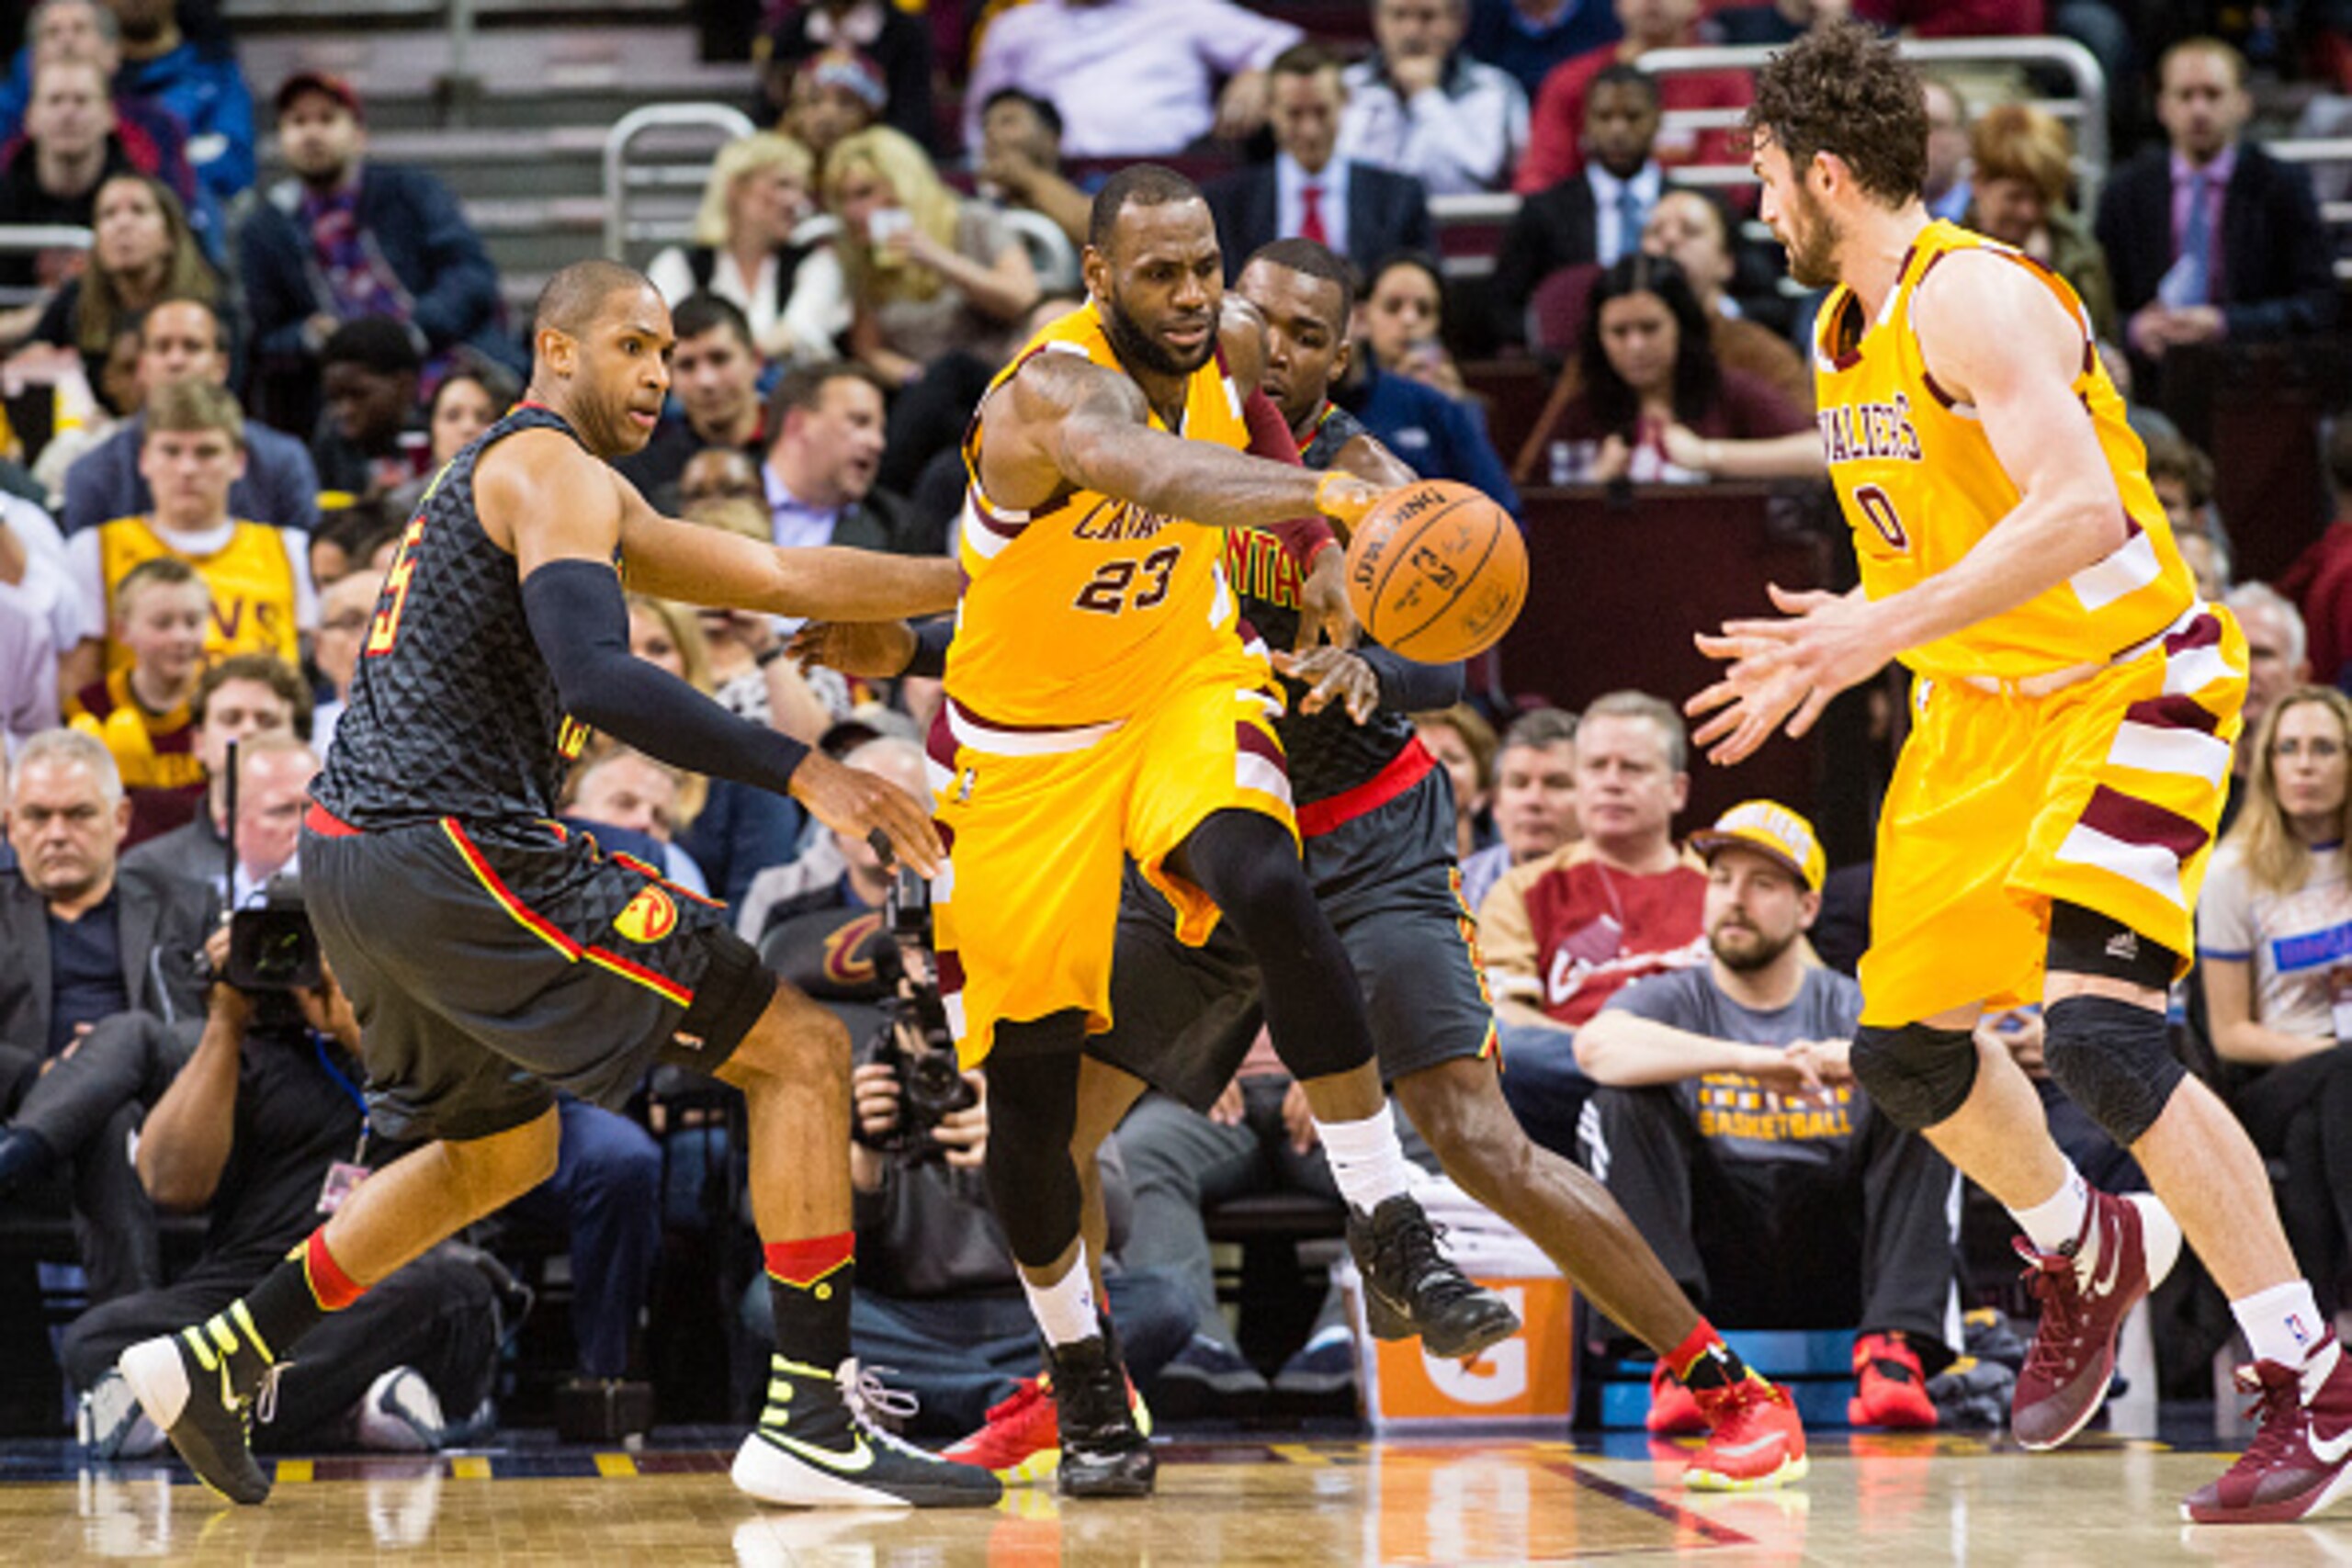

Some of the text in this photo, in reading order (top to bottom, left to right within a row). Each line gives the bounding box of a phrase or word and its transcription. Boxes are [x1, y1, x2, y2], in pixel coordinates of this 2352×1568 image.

[1853, 484, 1908, 551] 0
[1072, 543, 1182, 617] 23
[1699, 1109, 1852, 1143] BASKETBALL
[1420, 1286, 1528, 1406] G
